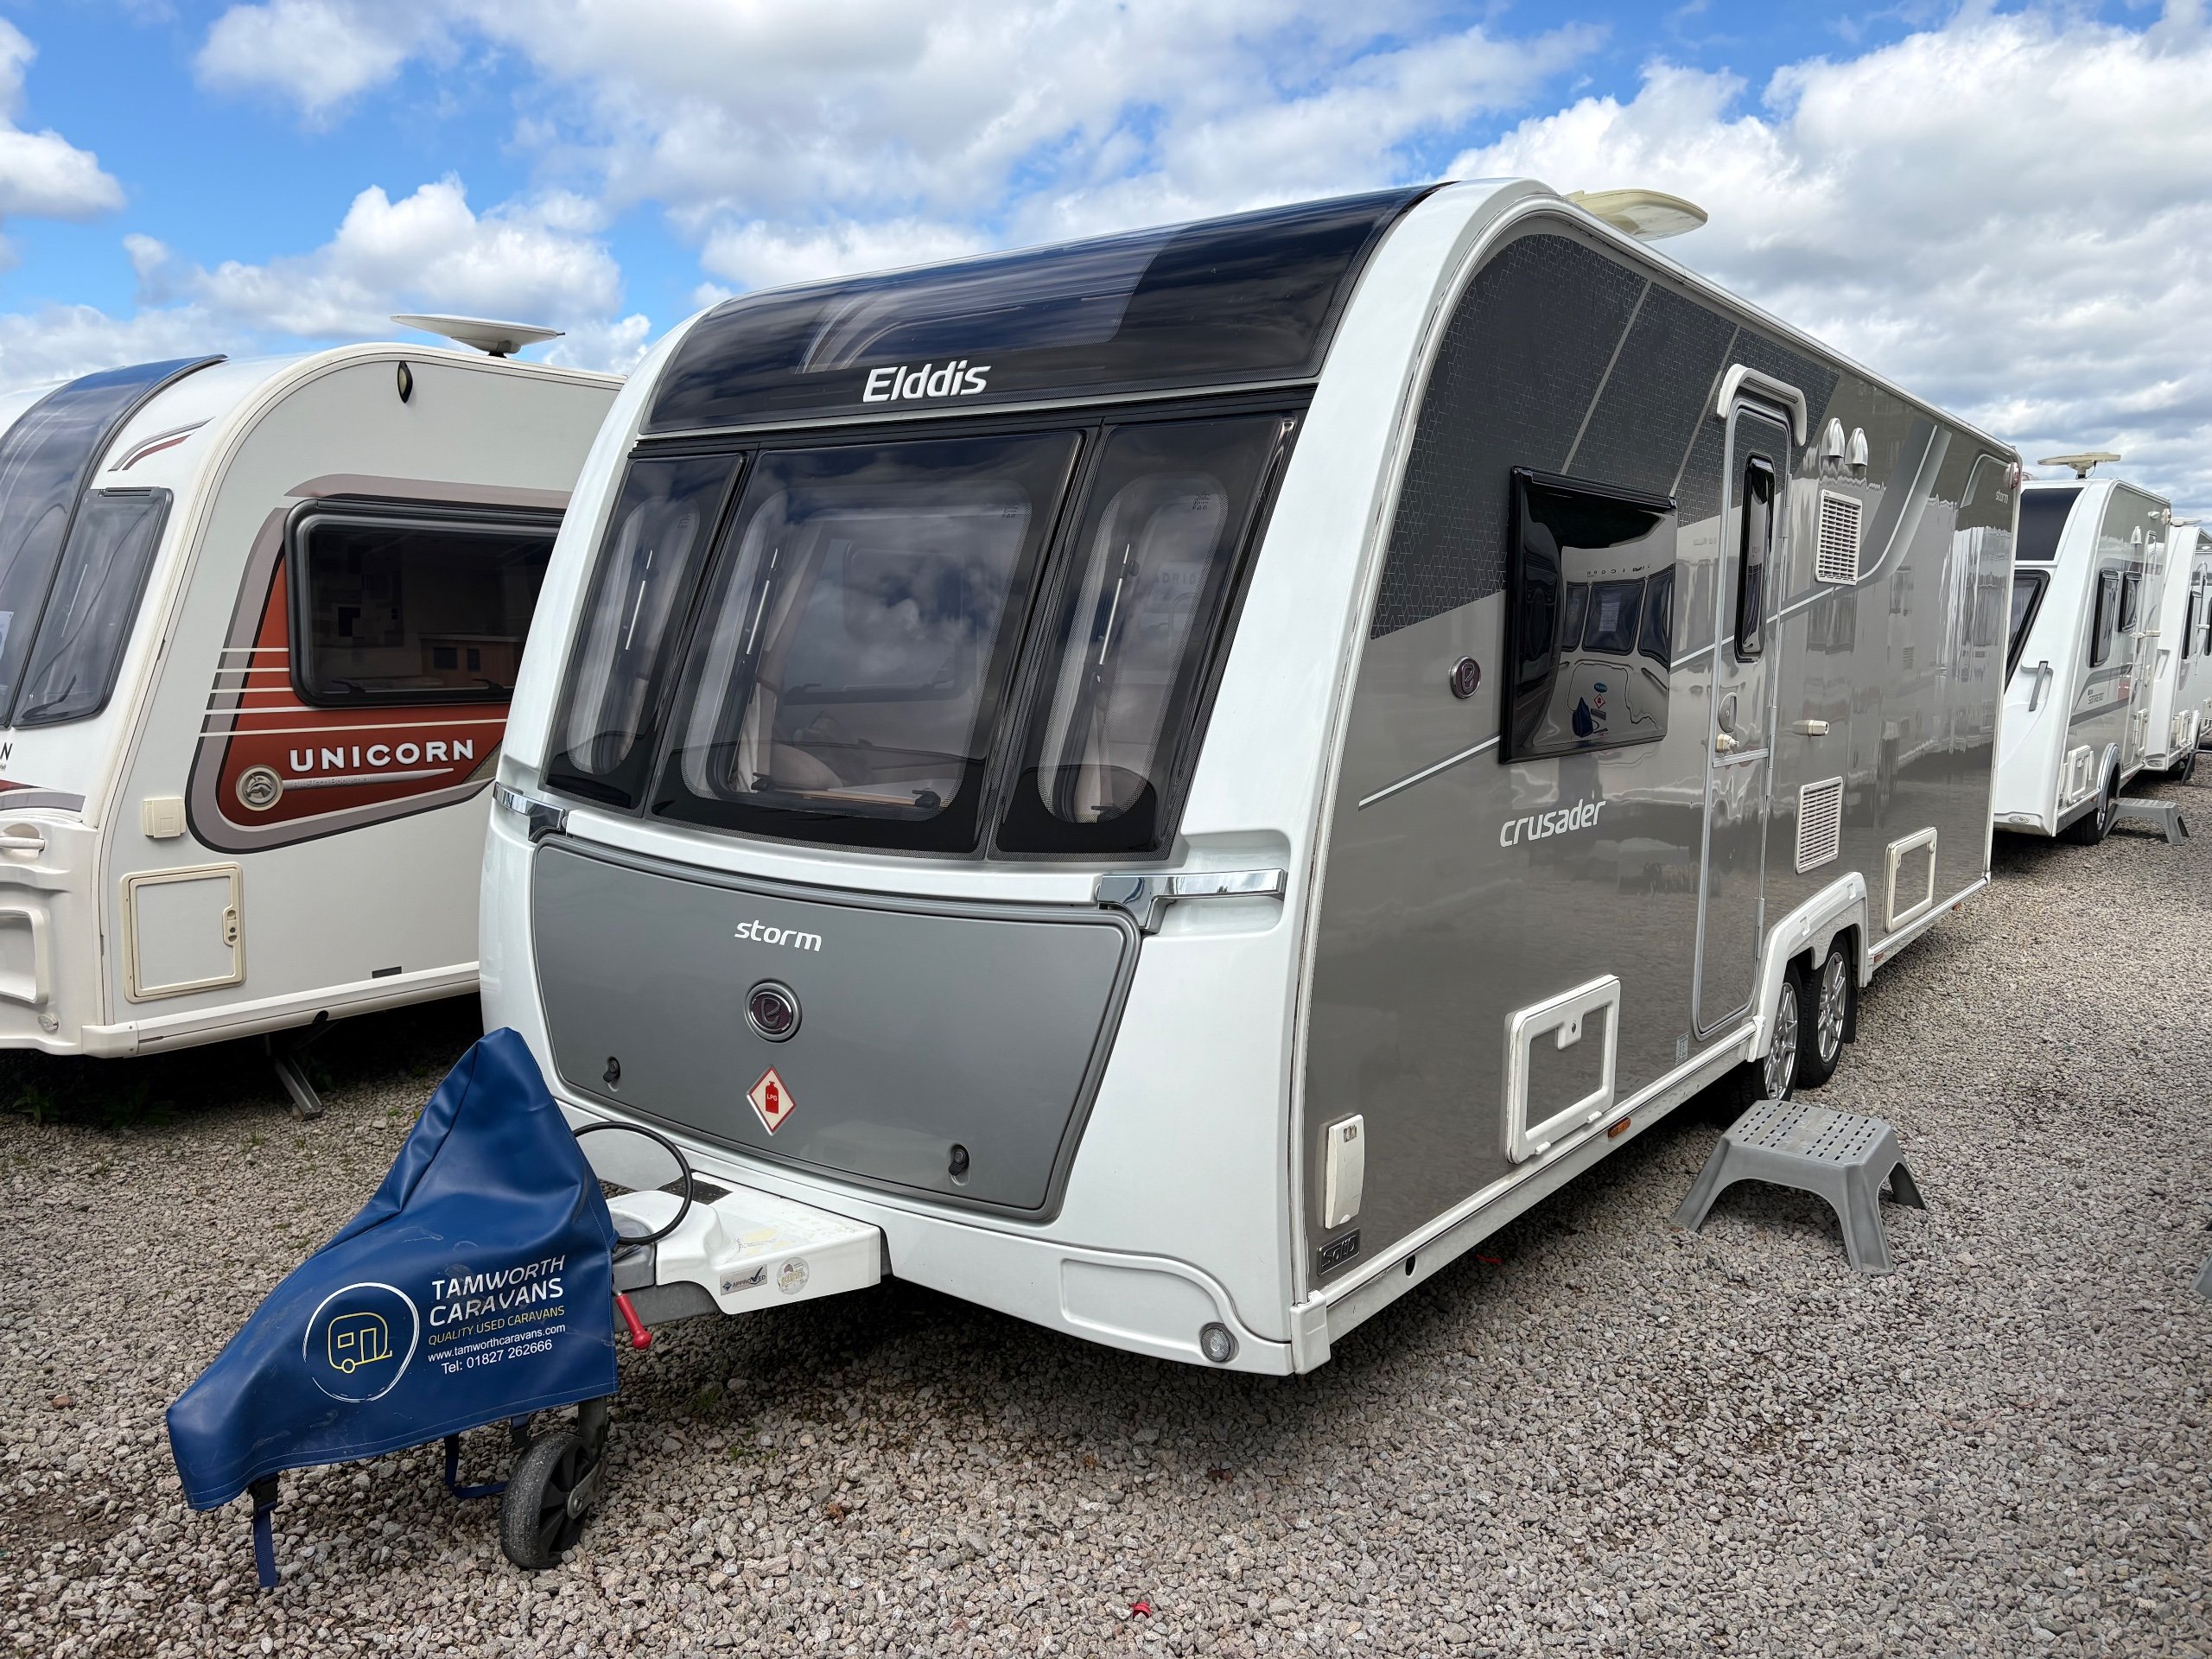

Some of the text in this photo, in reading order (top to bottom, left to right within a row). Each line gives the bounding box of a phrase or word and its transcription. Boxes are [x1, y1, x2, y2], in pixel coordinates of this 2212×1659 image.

[863, 360, 991, 402] Elddis
[289, 739, 474, 772] UNICORN
[1499, 798, 1606, 847] crusader
[734, 919, 822, 951] storm
[766, 1093, 778, 1102] LPG
[432, 1255, 566, 1300] TAMWORTH
[429, 1278, 563, 1326] CARAVANS
[428, 1324, 566, 1362] www.tamworthcaravans.com
[429, 1306, 565, 1345] QUALITY USED CARAVANS
[442, 1339, 552, 1375] Tel: 01827 262666
